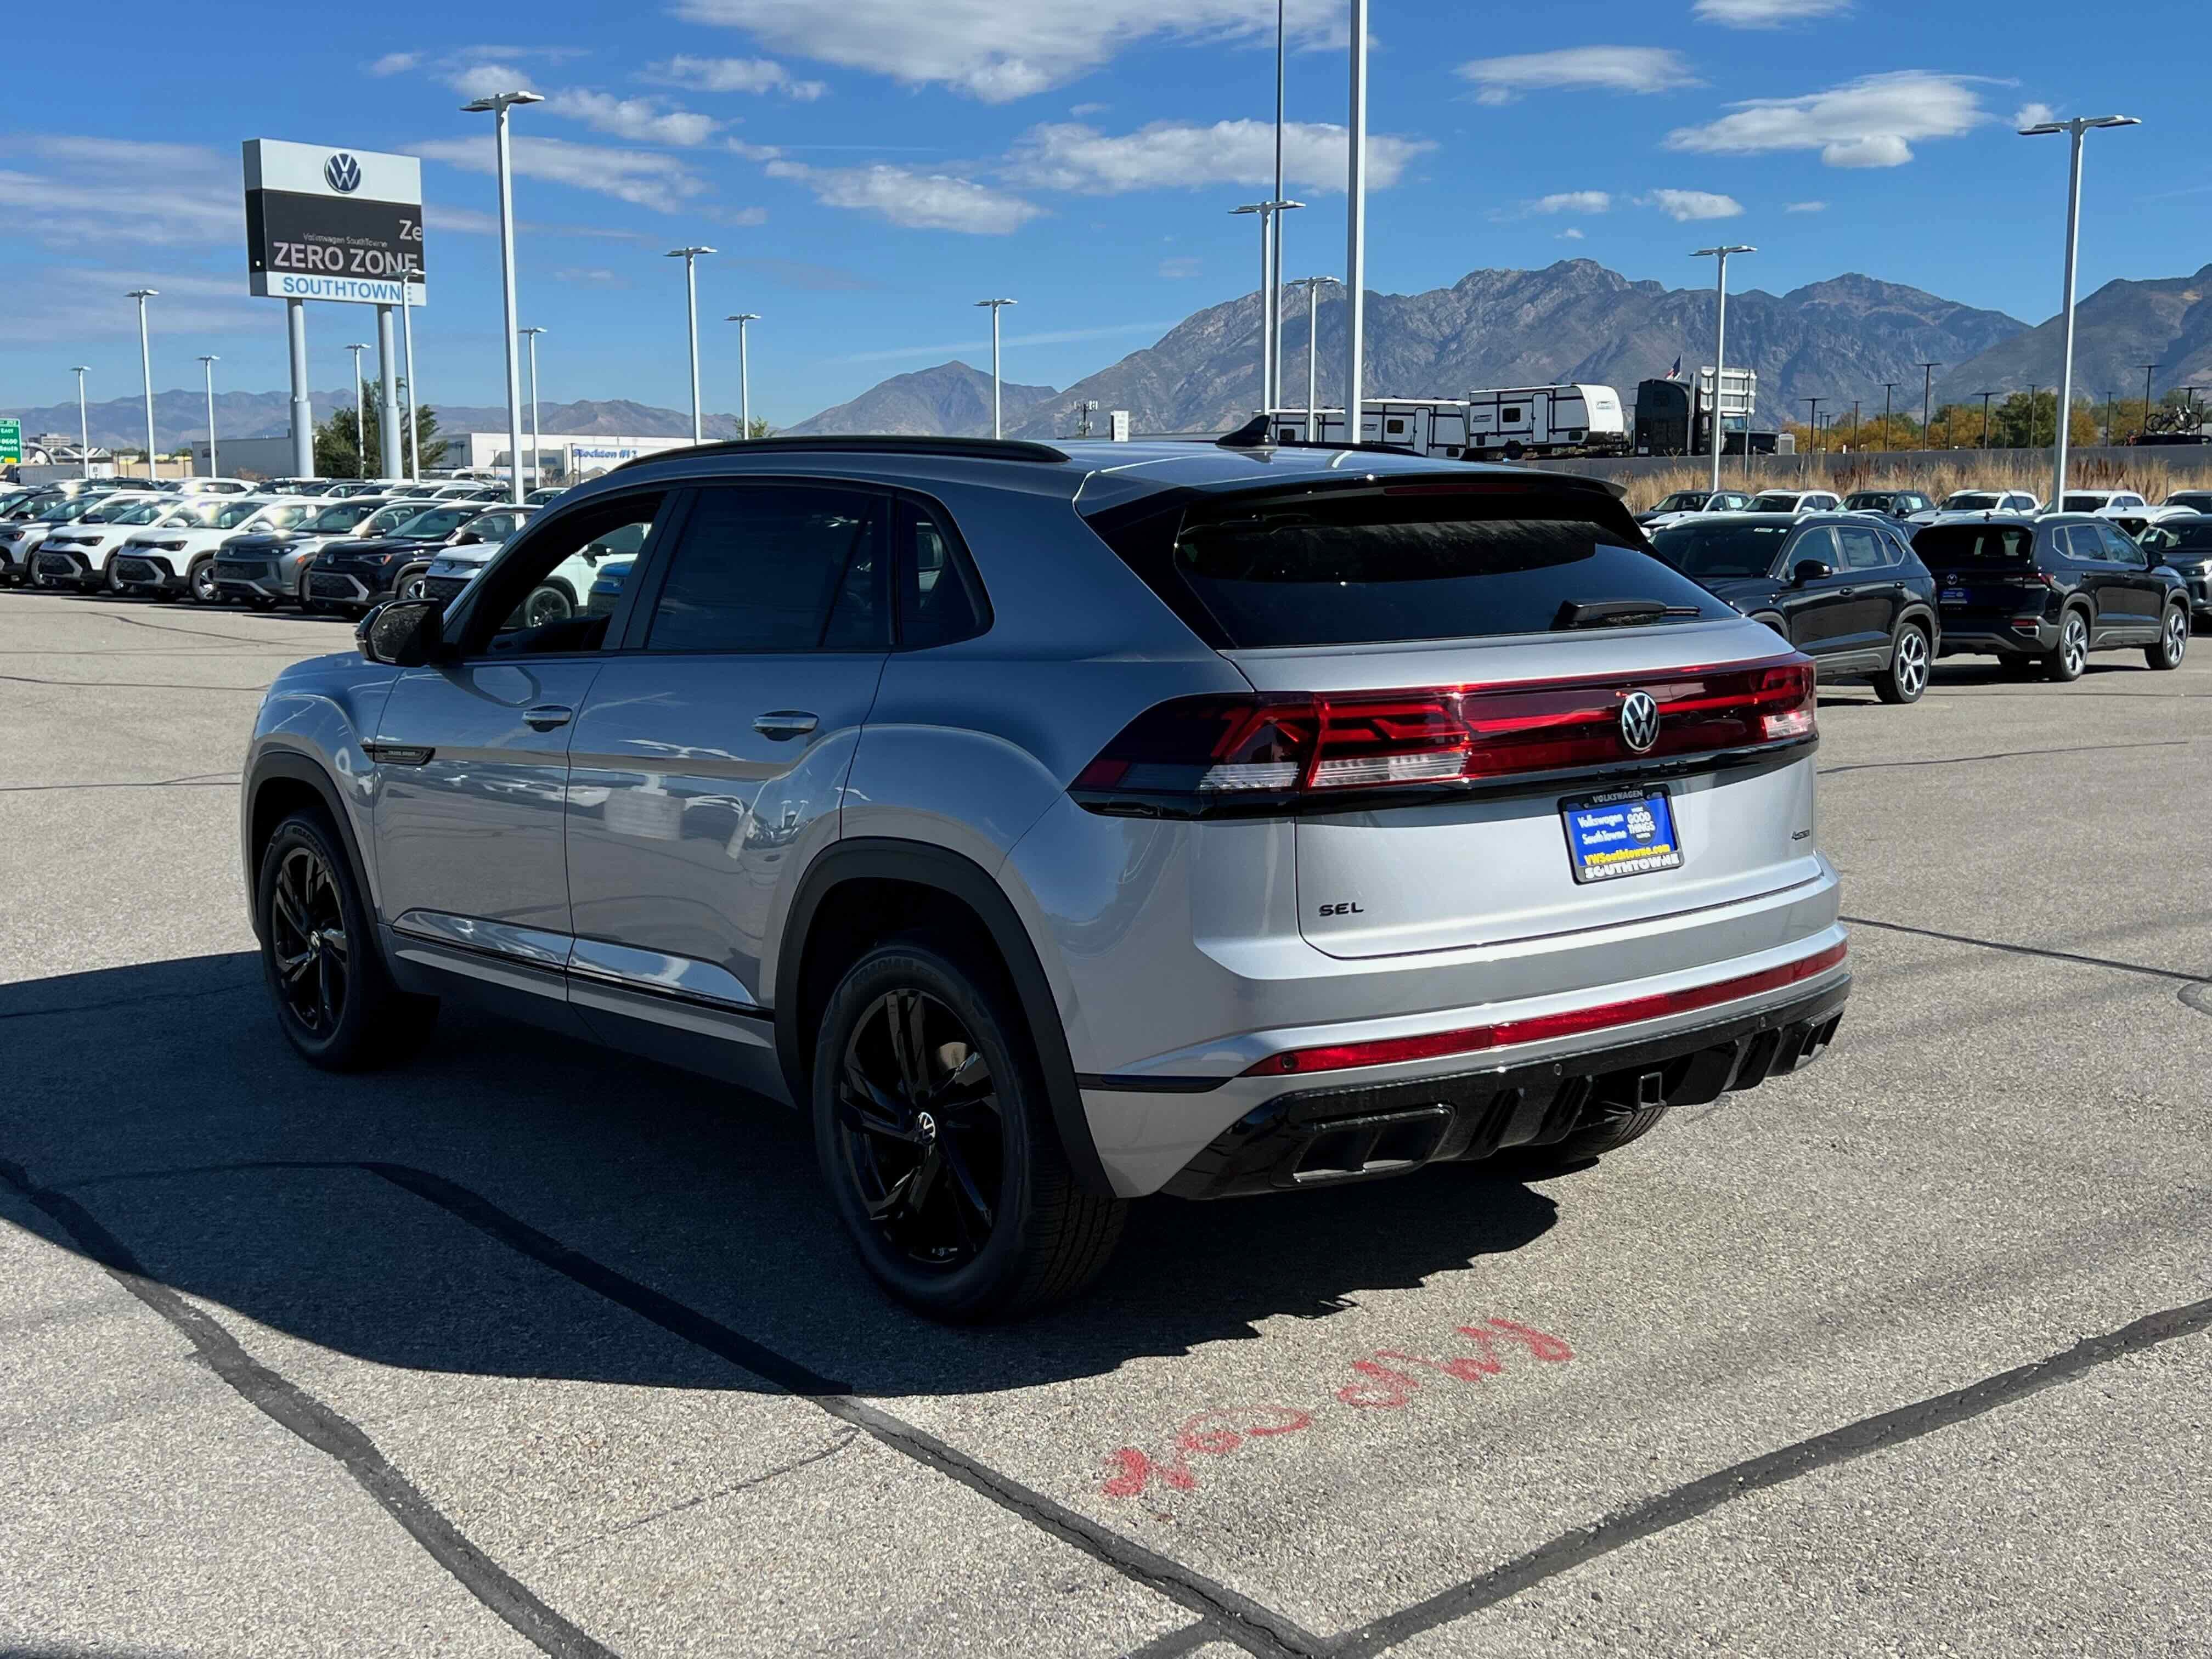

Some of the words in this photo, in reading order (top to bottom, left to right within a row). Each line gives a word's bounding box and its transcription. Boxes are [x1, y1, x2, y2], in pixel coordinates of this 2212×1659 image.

[399, 219, 421, 241] Ze
[273, 242, 344, 271] ZERO
[1593, 789, 1643, 803] VOLKSWAGEN
[1577, 814, 1624, 828] Volkswagen
[1627, 811, 1651, 824] GOOD
[1627, 821, 1656, 834] THINGS
[1585, 853, 1679, 879] SOUTHTOWNE
[1319, 901, 1364, 917] SEL
